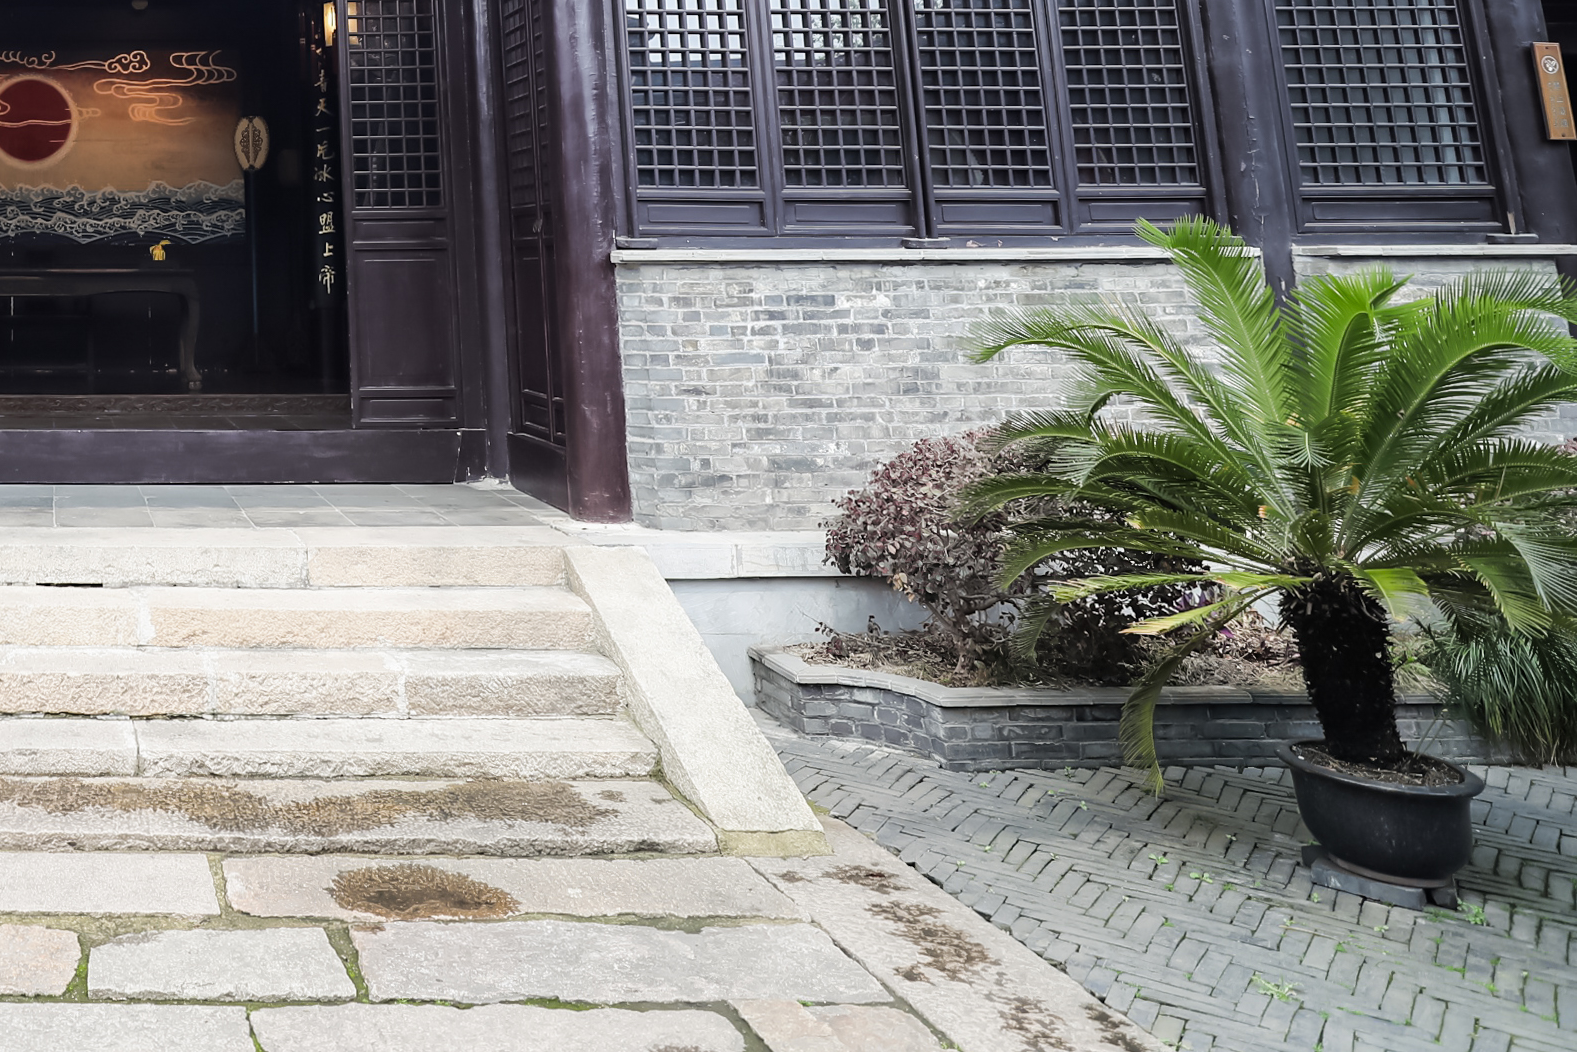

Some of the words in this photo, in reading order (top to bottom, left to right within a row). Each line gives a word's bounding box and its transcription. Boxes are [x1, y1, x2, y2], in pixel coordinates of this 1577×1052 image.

[313, 44, 337, 295] 青天一片冰心盟上帝
